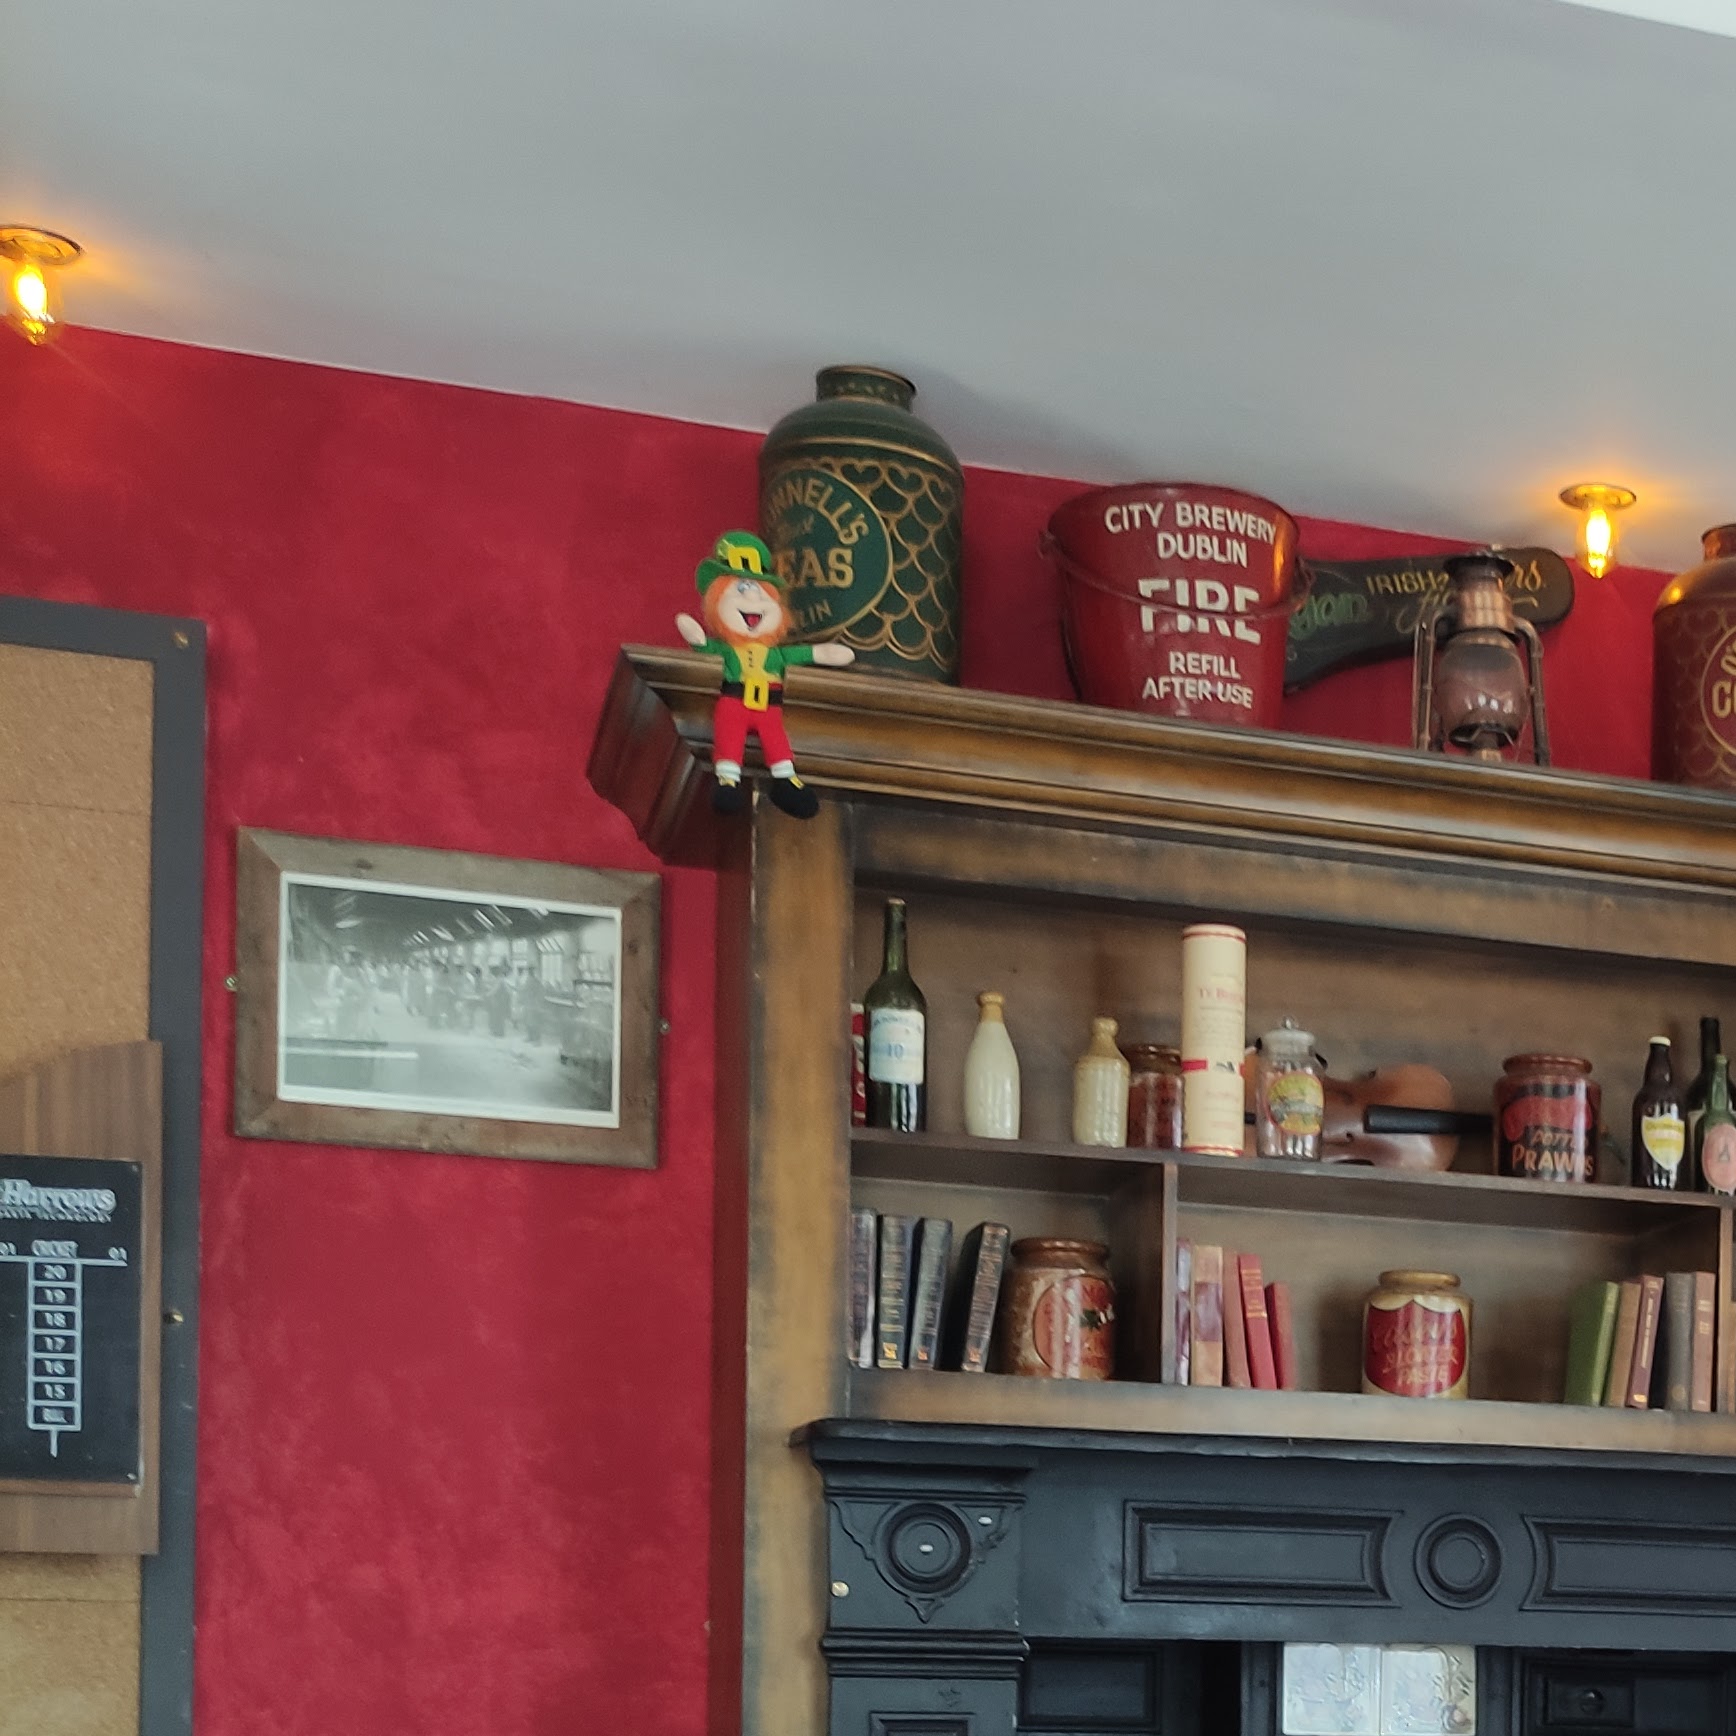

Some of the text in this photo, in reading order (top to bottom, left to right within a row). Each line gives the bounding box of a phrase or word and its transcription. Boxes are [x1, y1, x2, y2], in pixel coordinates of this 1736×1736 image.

[1104, 501, 1277, 545] CITY BREWERY
[1156, 531, 1248, 568] DUBLIN
[774, 547, 854, 588] EAS
[1137, 578, 1262, 646] FIRE
[1169, 651, 1242, 680] REFILL
[1141, 676, 1254, 709] AFTER USE
[1511, 1143, 1594, 1177] PRAWS
[44, 1264, 68, 1280] 20
[44, 1312, 67, 1328] 18
